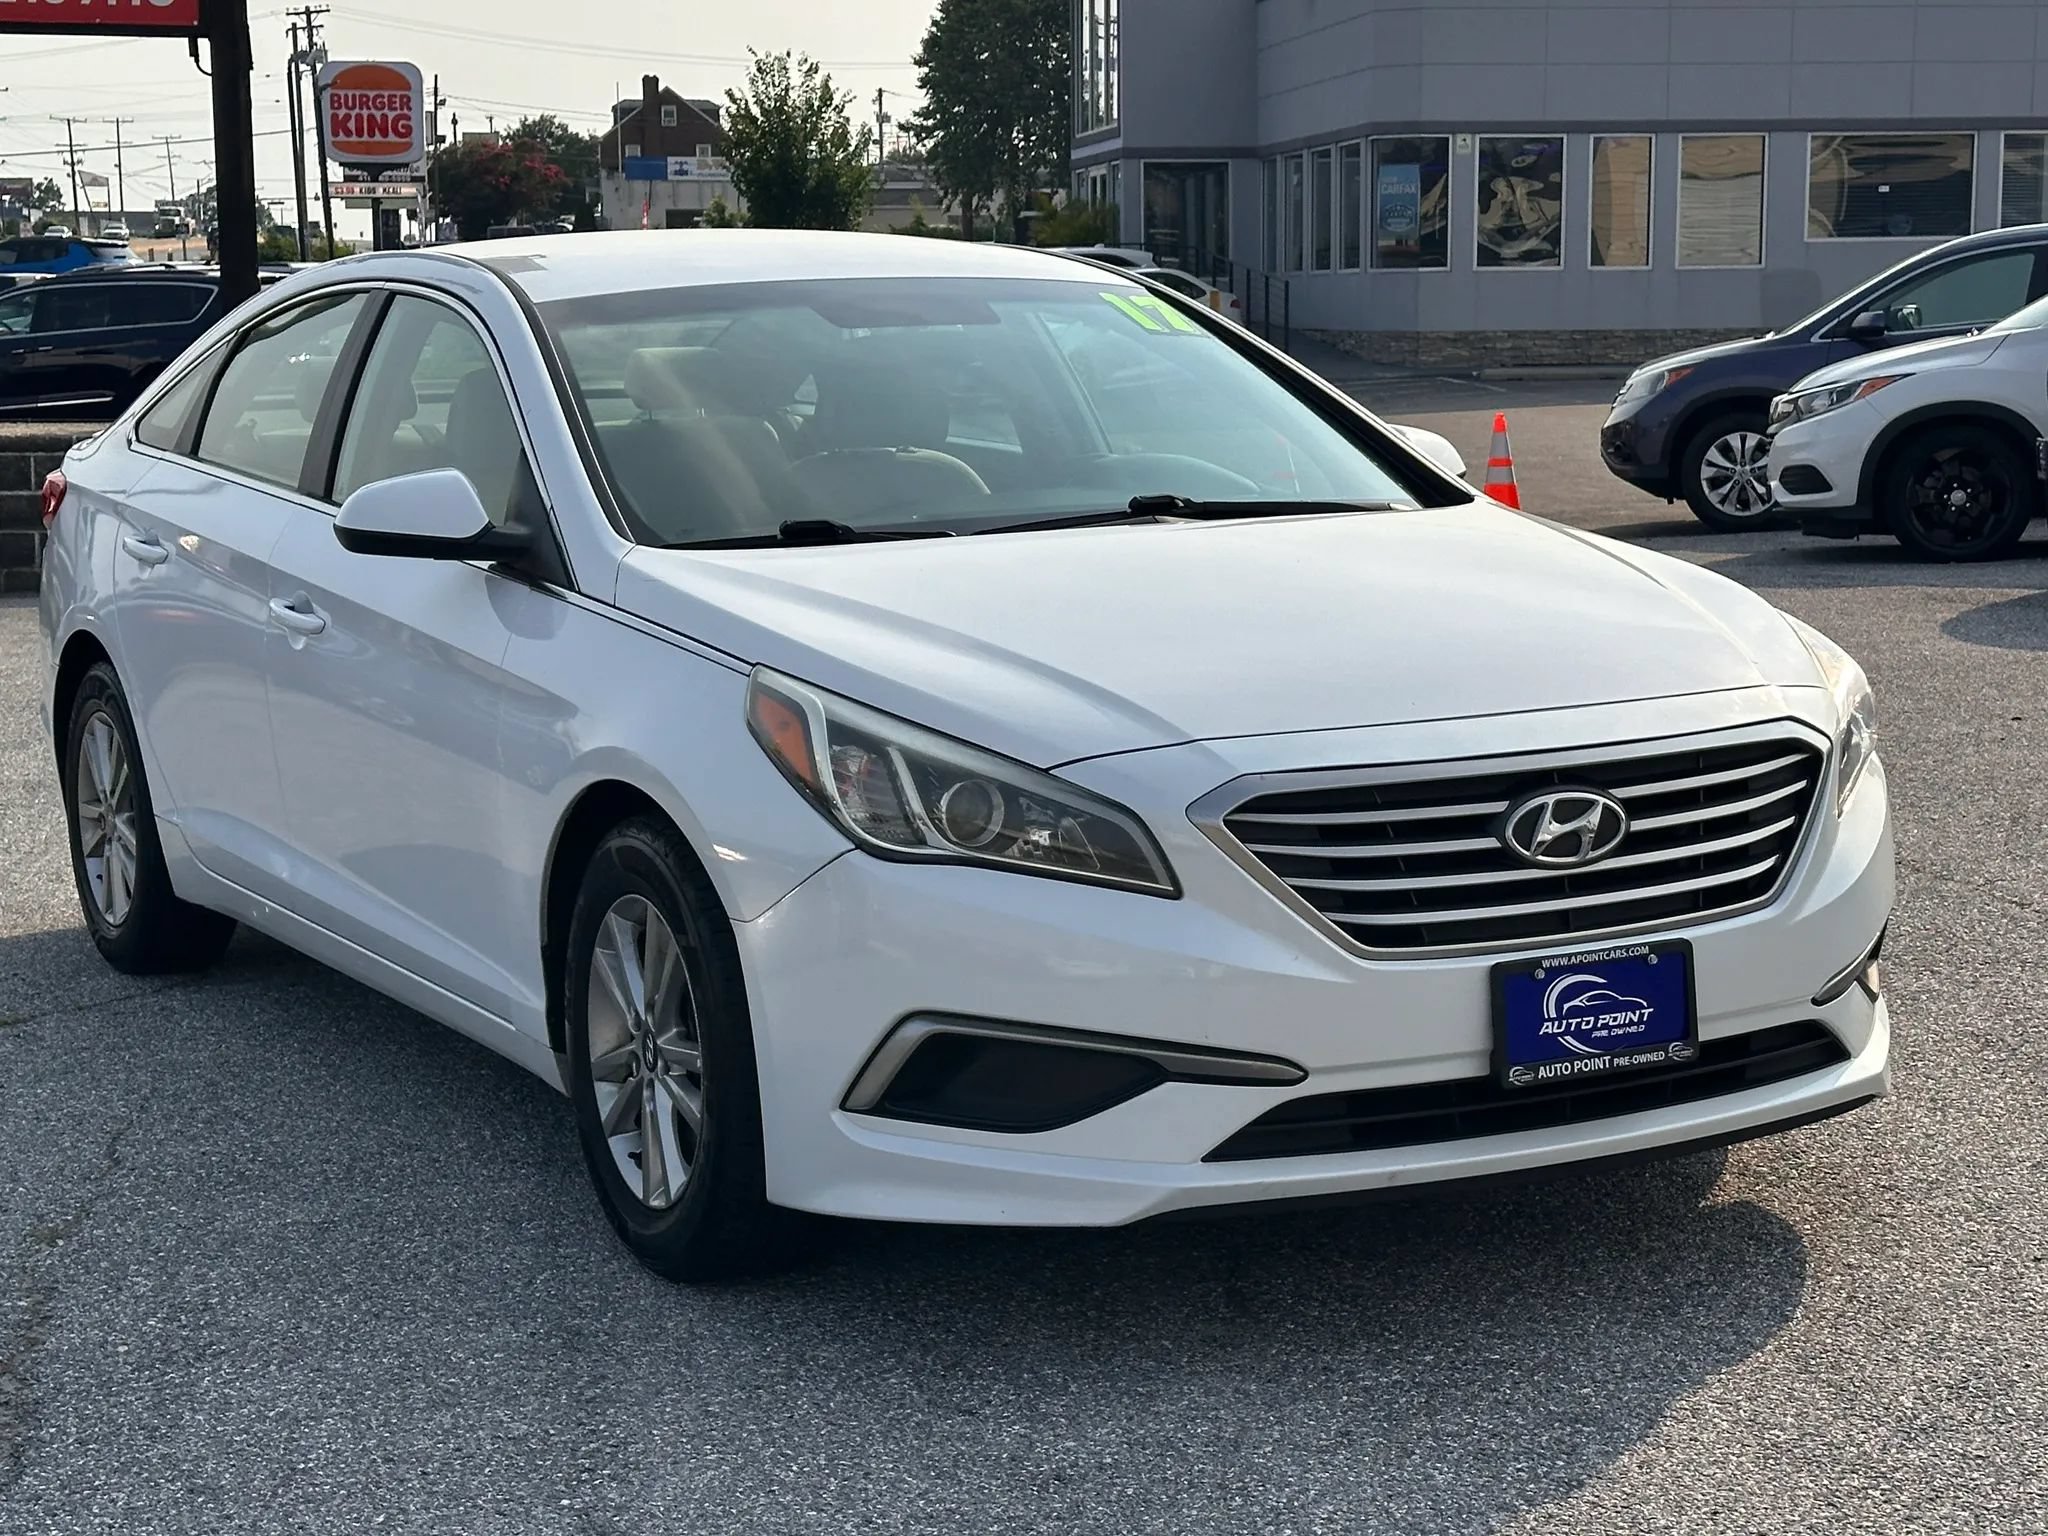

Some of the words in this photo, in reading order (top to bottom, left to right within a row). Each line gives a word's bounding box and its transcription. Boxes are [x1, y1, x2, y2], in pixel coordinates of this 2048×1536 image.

[330, 93, 412, 111] BURGER
[331, 113, 413, 139] KING
[1380, 183, 1417, 194] CARFAX
[1098, 292, 1203, 336] 17
[1541, 946, 1649, 968] WWW.APOINTCARS.COM
[1539, 1016, 1594, 1035] AUTO
[1597, 1008, 1654, 1027] POINT
[1610, 1024, 1645, 1036] OWNED
[1538, 1062, 1572, 1079] AUTO
[1574, 1056, 1612, 1073] POINT
[1613, 1051, 1665, 1067] PRE-OWNED
